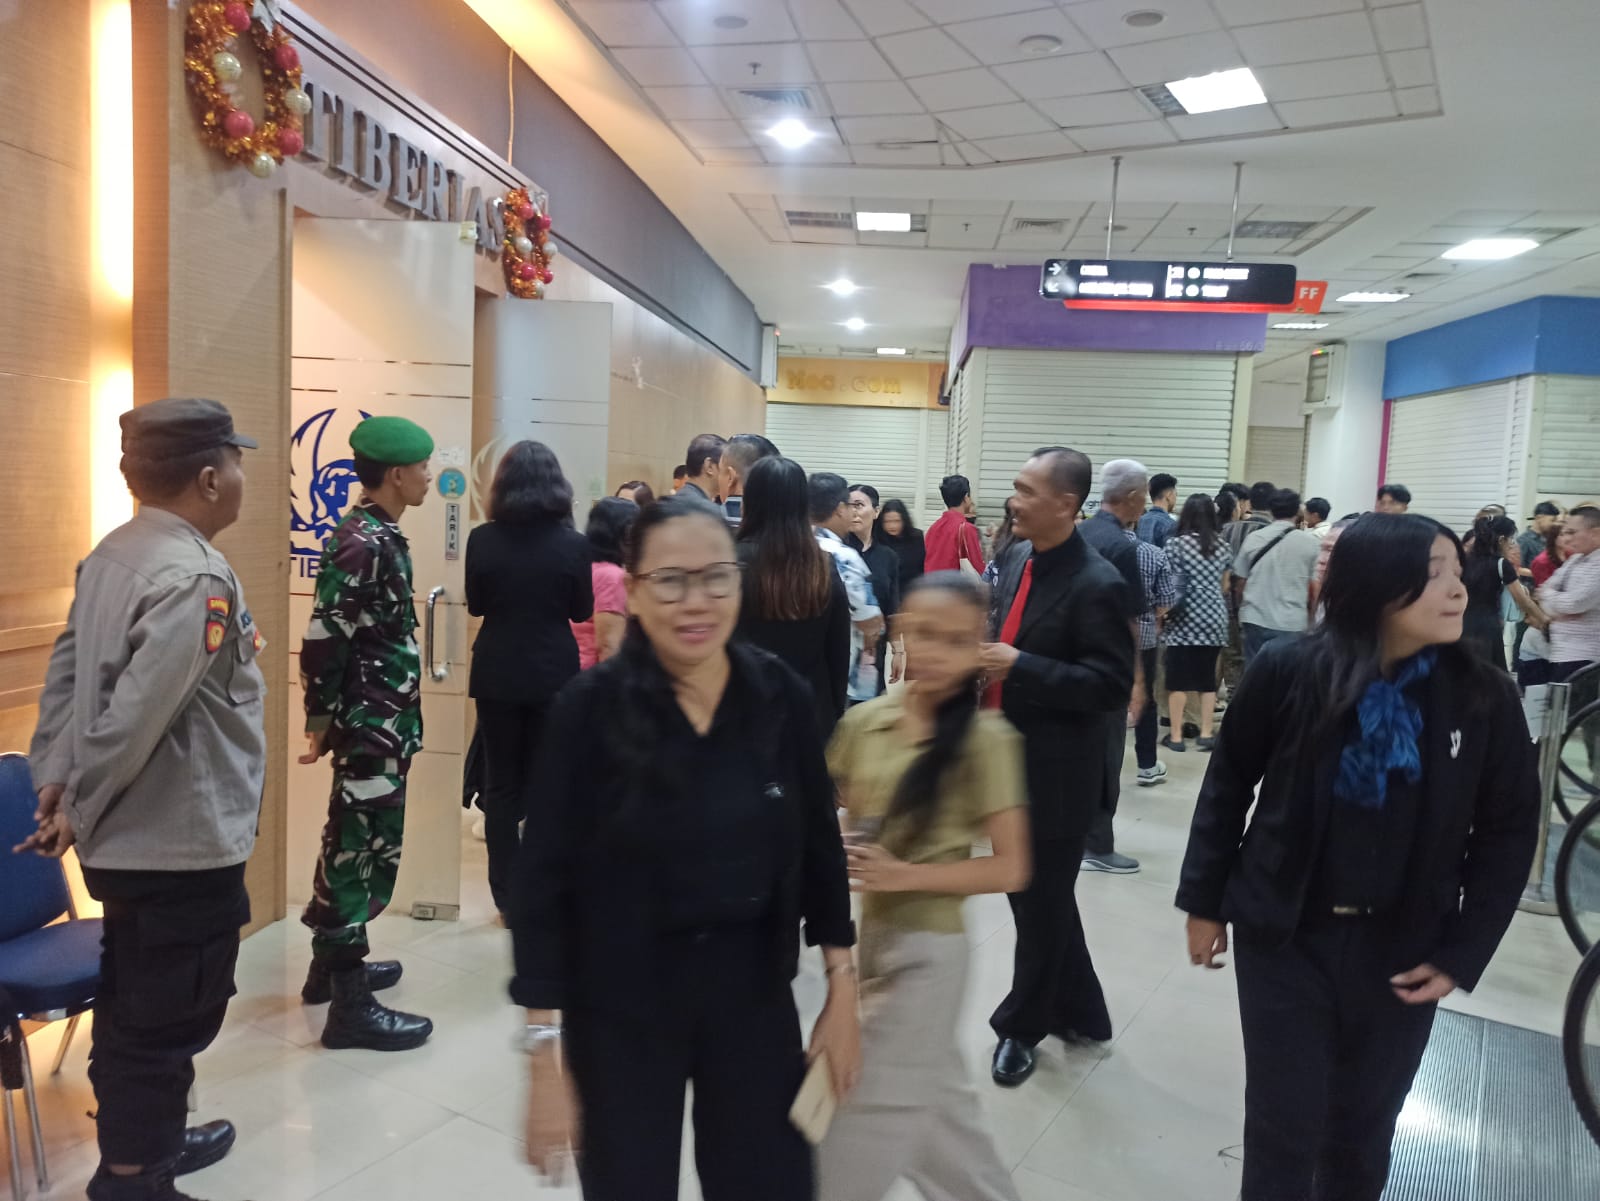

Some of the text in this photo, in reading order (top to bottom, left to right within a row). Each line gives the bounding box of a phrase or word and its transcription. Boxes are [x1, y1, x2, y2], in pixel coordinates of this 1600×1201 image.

[302, 73, 504, 250] TIBERIAS
[1299, 287, 1319, 300] FF
[449, 504, 457, 550] TARIK
